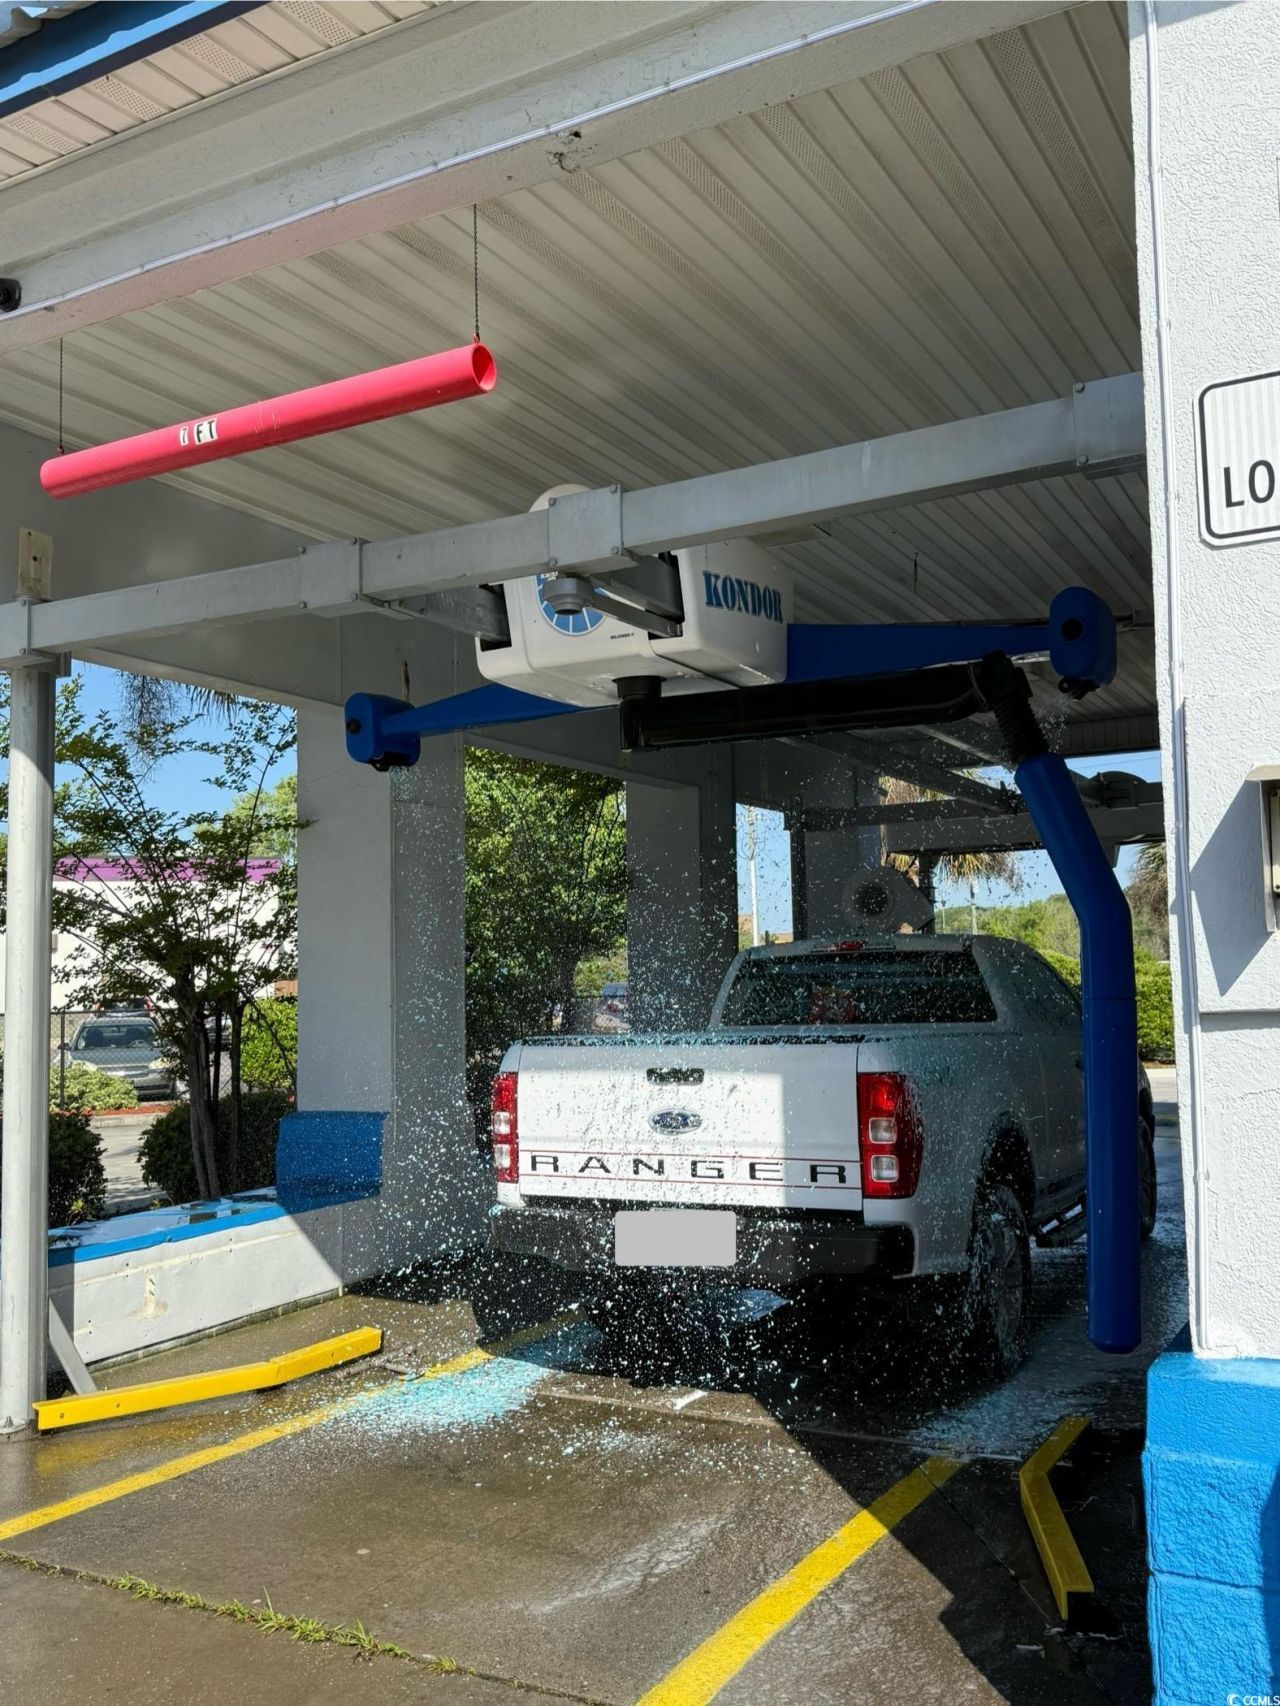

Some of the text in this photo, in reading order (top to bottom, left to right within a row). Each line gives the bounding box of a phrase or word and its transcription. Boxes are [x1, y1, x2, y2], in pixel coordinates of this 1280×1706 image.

[182, 420, 215, 444] 7 FT
[703, 571, 783, 624] KONDOR
[531, 1154, 847, 1184] RANGER
